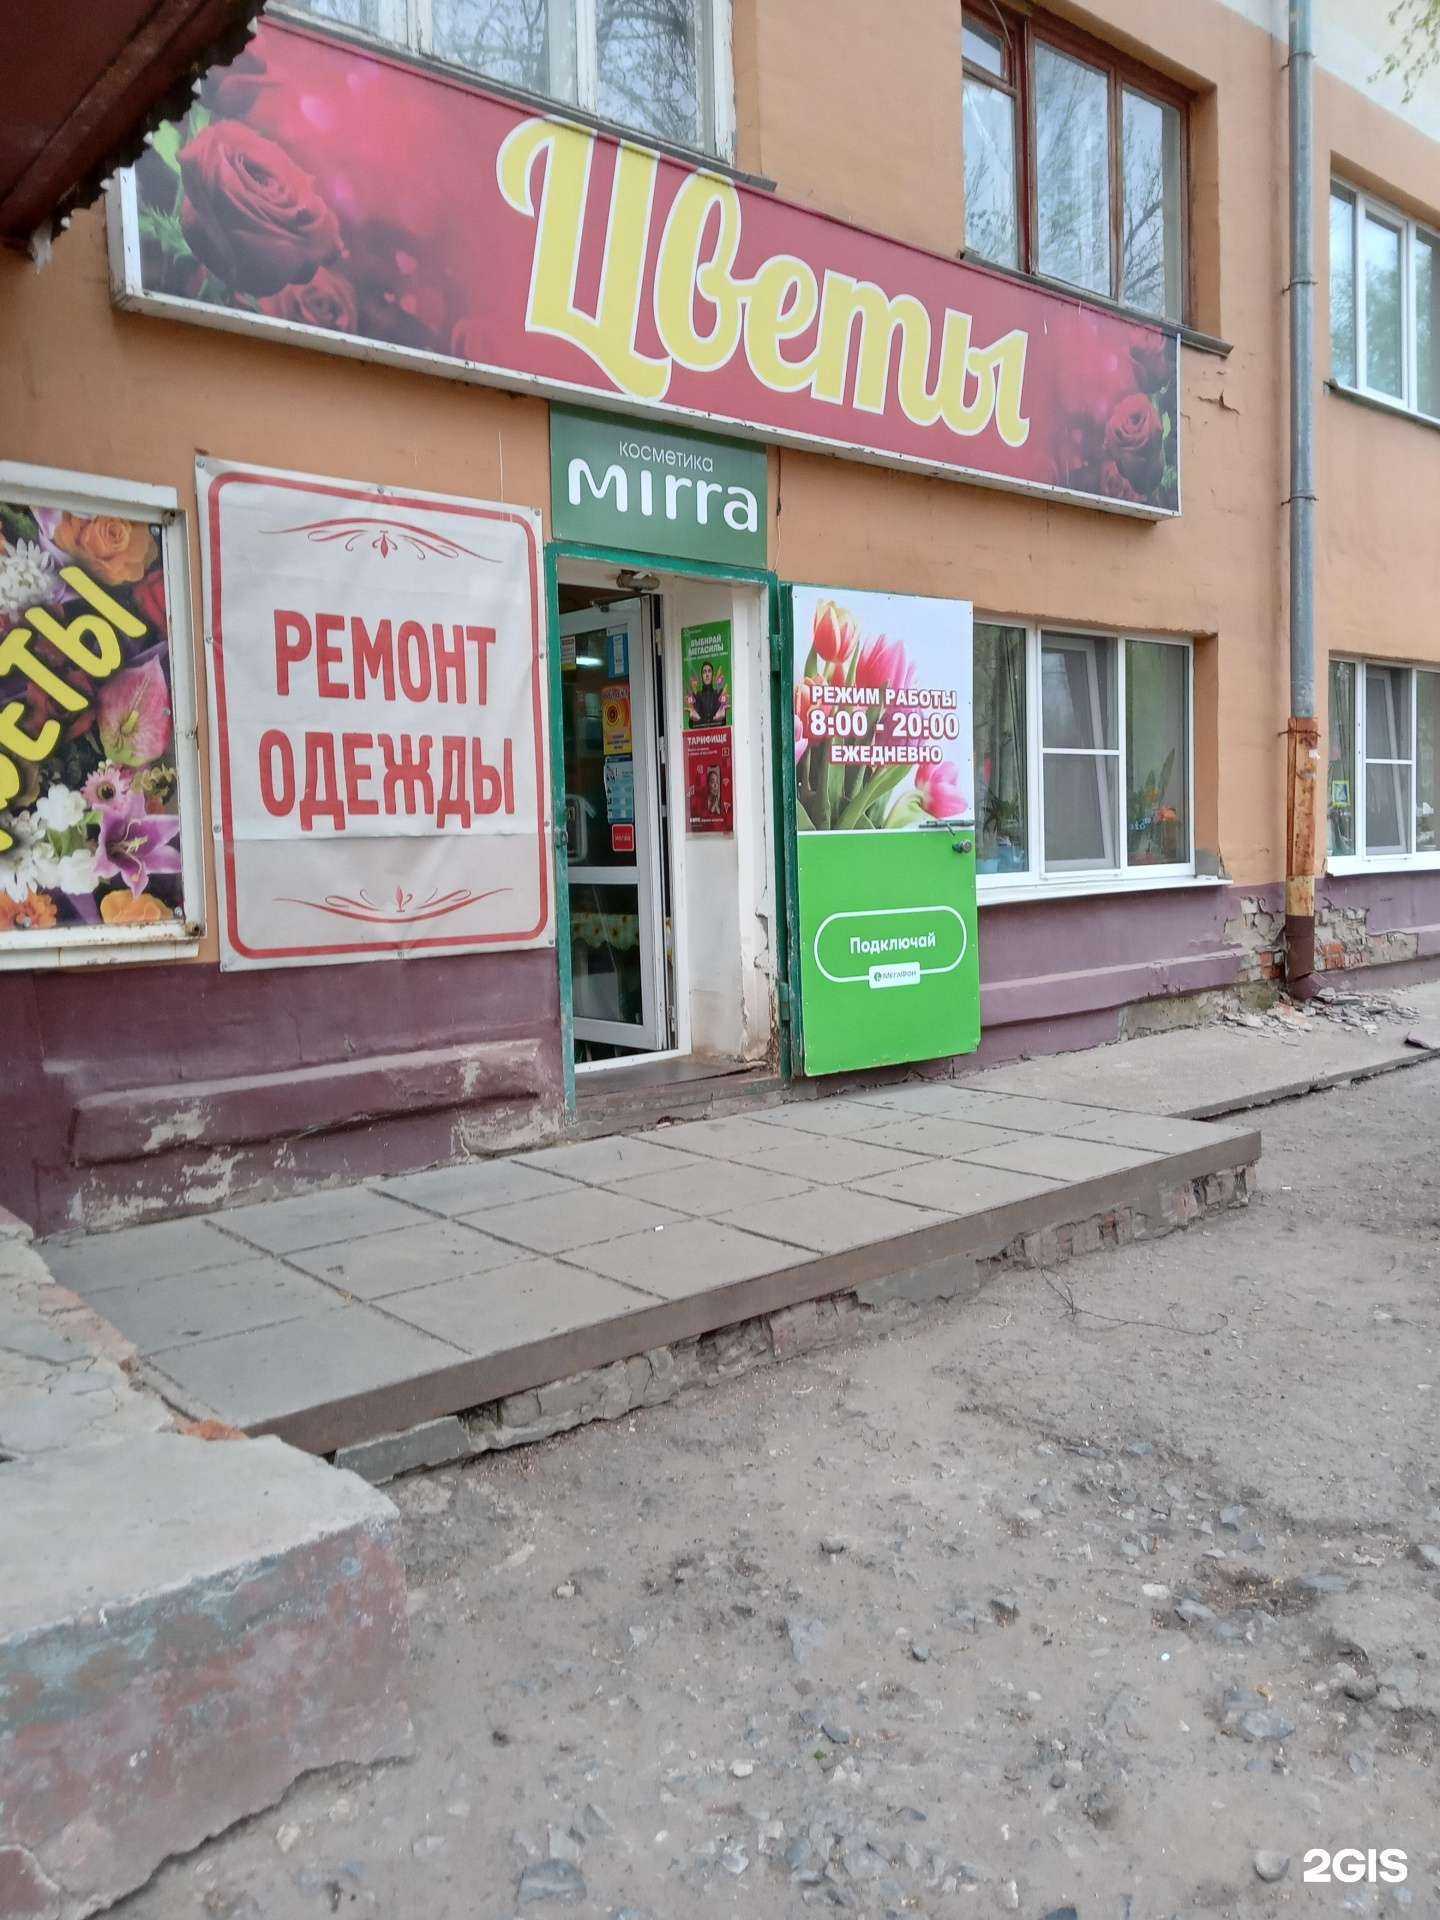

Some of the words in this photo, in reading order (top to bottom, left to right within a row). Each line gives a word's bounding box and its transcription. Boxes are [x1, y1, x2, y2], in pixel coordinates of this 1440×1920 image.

[496, 114, 1030, 447] Цветы
[619, 441, 714, 473] косметика
[274, 609, 496, 705] РЕМОНТ
[812, 686, 880, 705] РЕЖИМ
[886, 688, 957, 709] РАБОТЫ
[687, 733, 728, 745] ТАРИФИЩЕ
[810, 709, 868, 737] 8:00
[892, 711, 960, 739] 20:00
[831, 745, 943, 765] ЕЖЕДНЕВНО
[258, 729, 515, 831] ОДЕЖДЫ
[849, 931, 936, 955] Подключай
